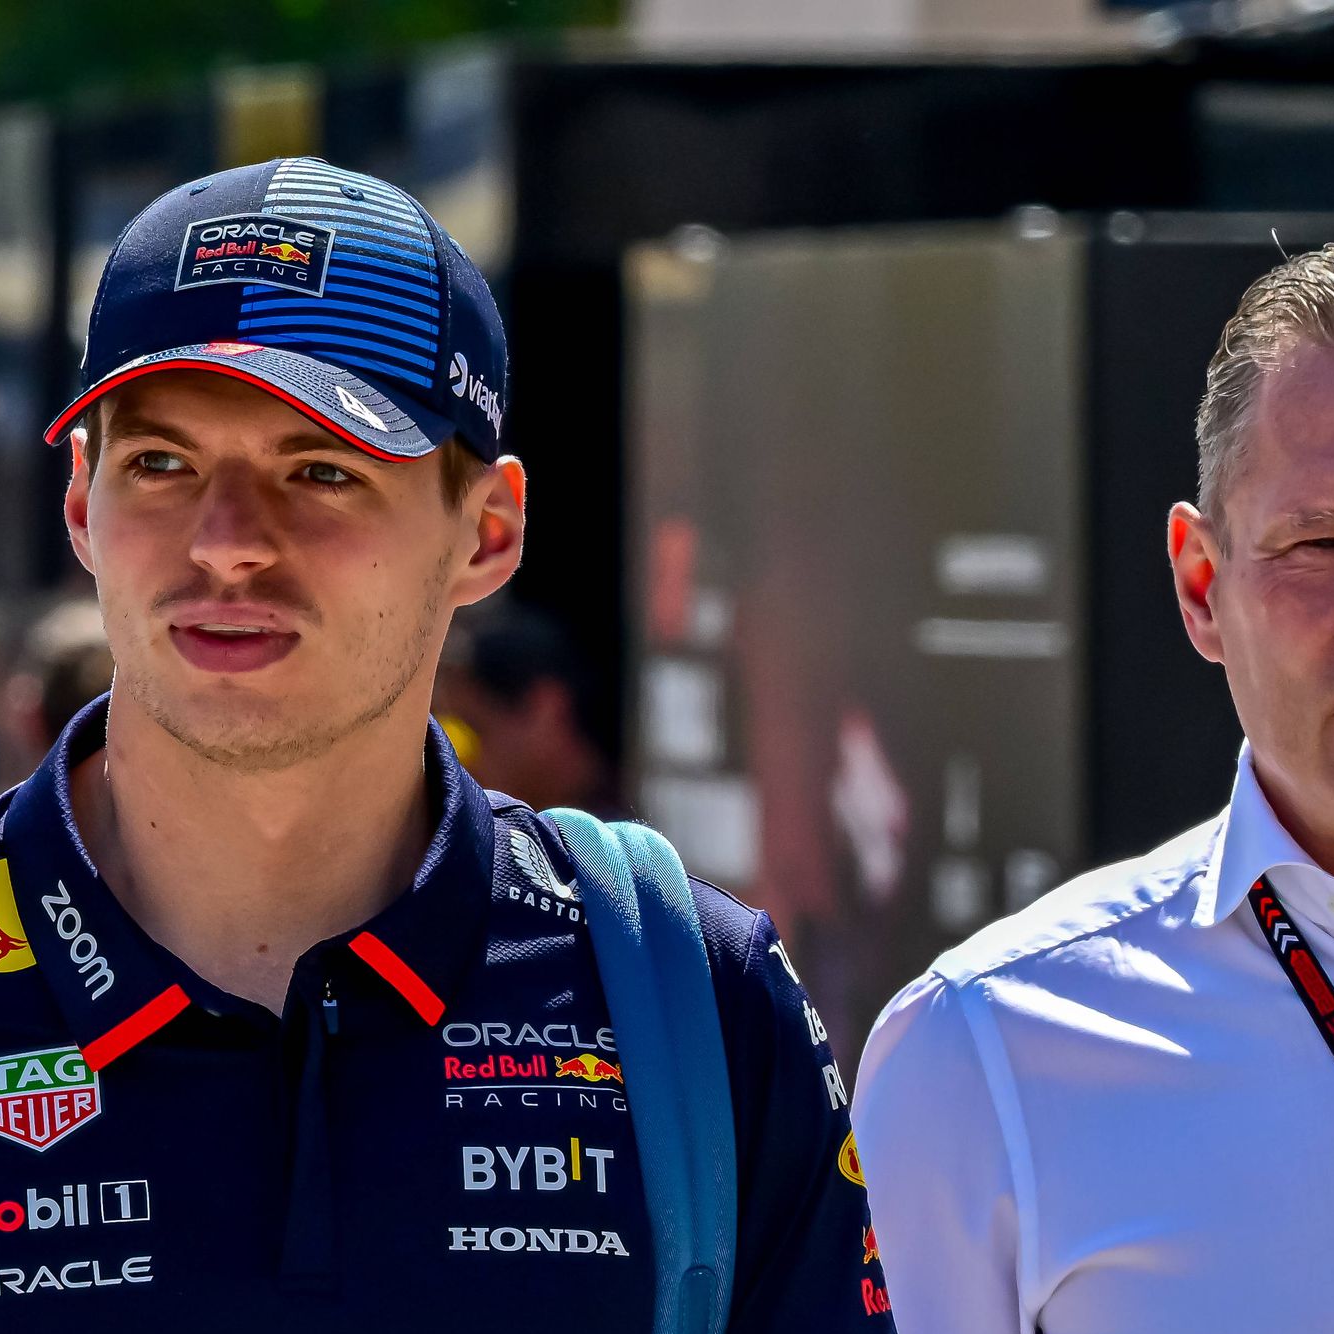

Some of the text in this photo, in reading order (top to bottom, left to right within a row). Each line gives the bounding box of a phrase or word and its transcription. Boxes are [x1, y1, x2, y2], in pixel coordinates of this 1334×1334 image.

[199, 223, 316, 248] ORACLE
[195, 240, 257, 261] Red Bull
[192, 262, 309, 282] RACING
[509, 886, 588, 925] CASTO
[41, 879, 115, 1001] zoom
[442, 1022, 618, 1052] ORACLE
[444, 1055, 548, 1080] Red Bull
[445, 1092, 628, 1112] RACING
[462, 1137, 615, 1193] BYBIT
[448, 1226, 630, 1257] HONDA
